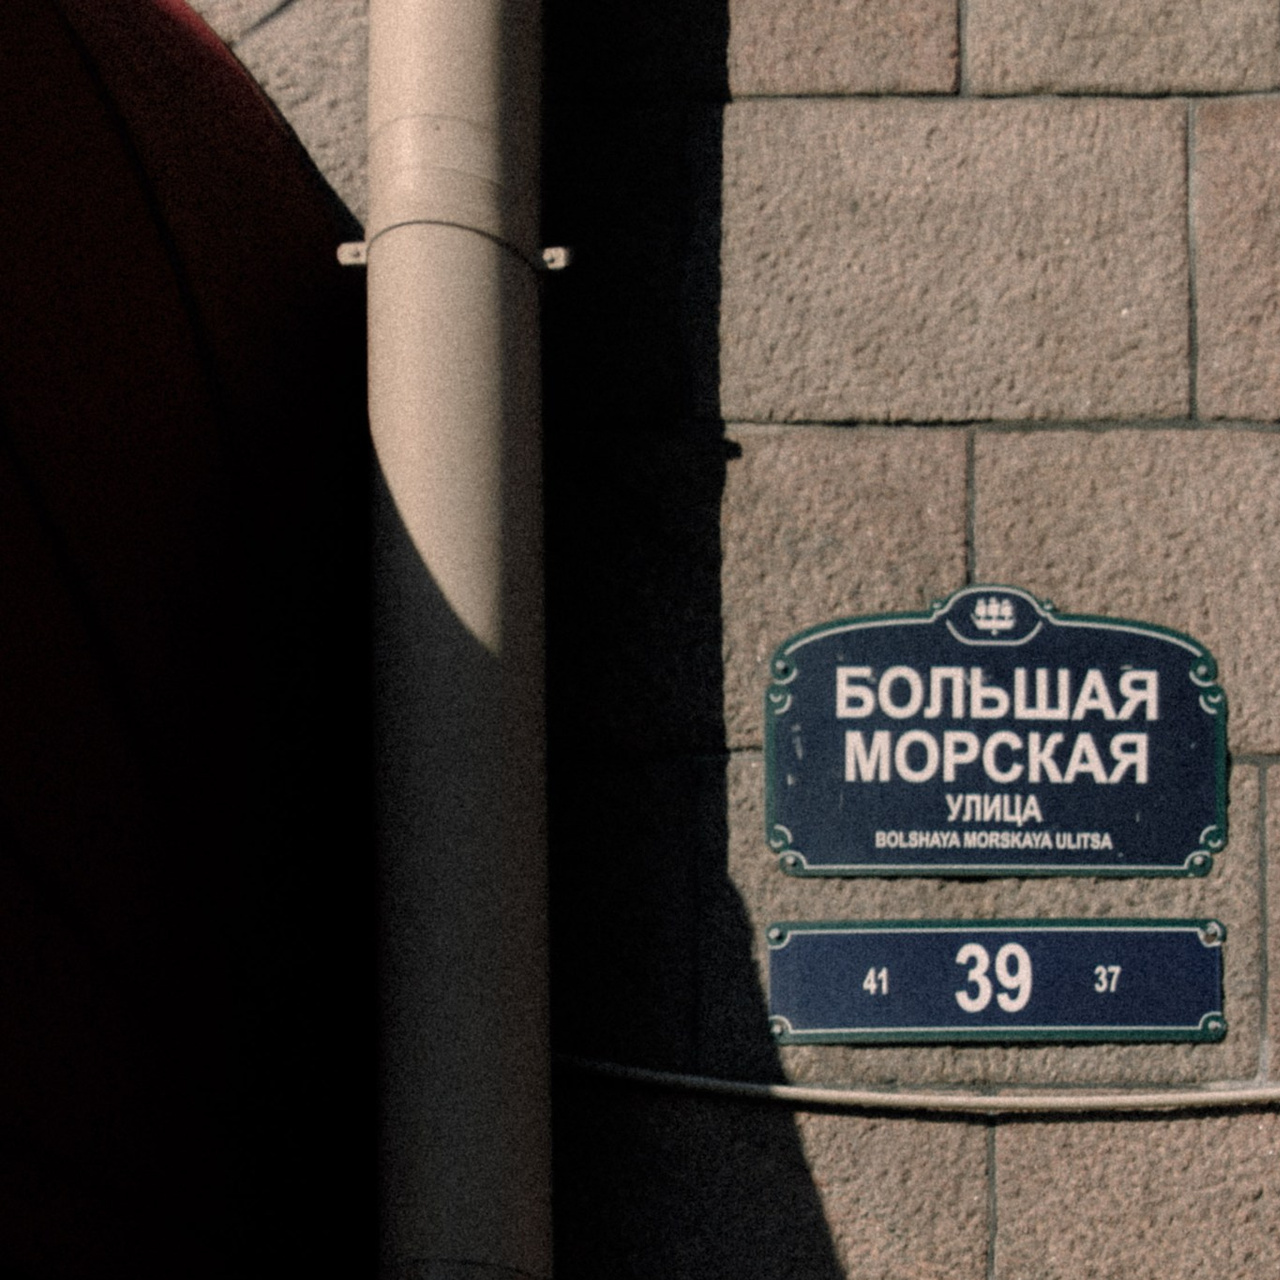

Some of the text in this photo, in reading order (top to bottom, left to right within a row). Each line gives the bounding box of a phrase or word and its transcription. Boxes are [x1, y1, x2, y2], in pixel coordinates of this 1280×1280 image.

[835, 665, 1159, 721] БОЛЬШАЯ
[844, 730, 1149, 784] МОРСКАЯ
[945, 794, 1043, 827] УЛИЦА
[875, 830, 1113, 850] BOLSHAYA MORSKAYA ULITSA
[862, 942, 1121, 1013] 41 39 37
